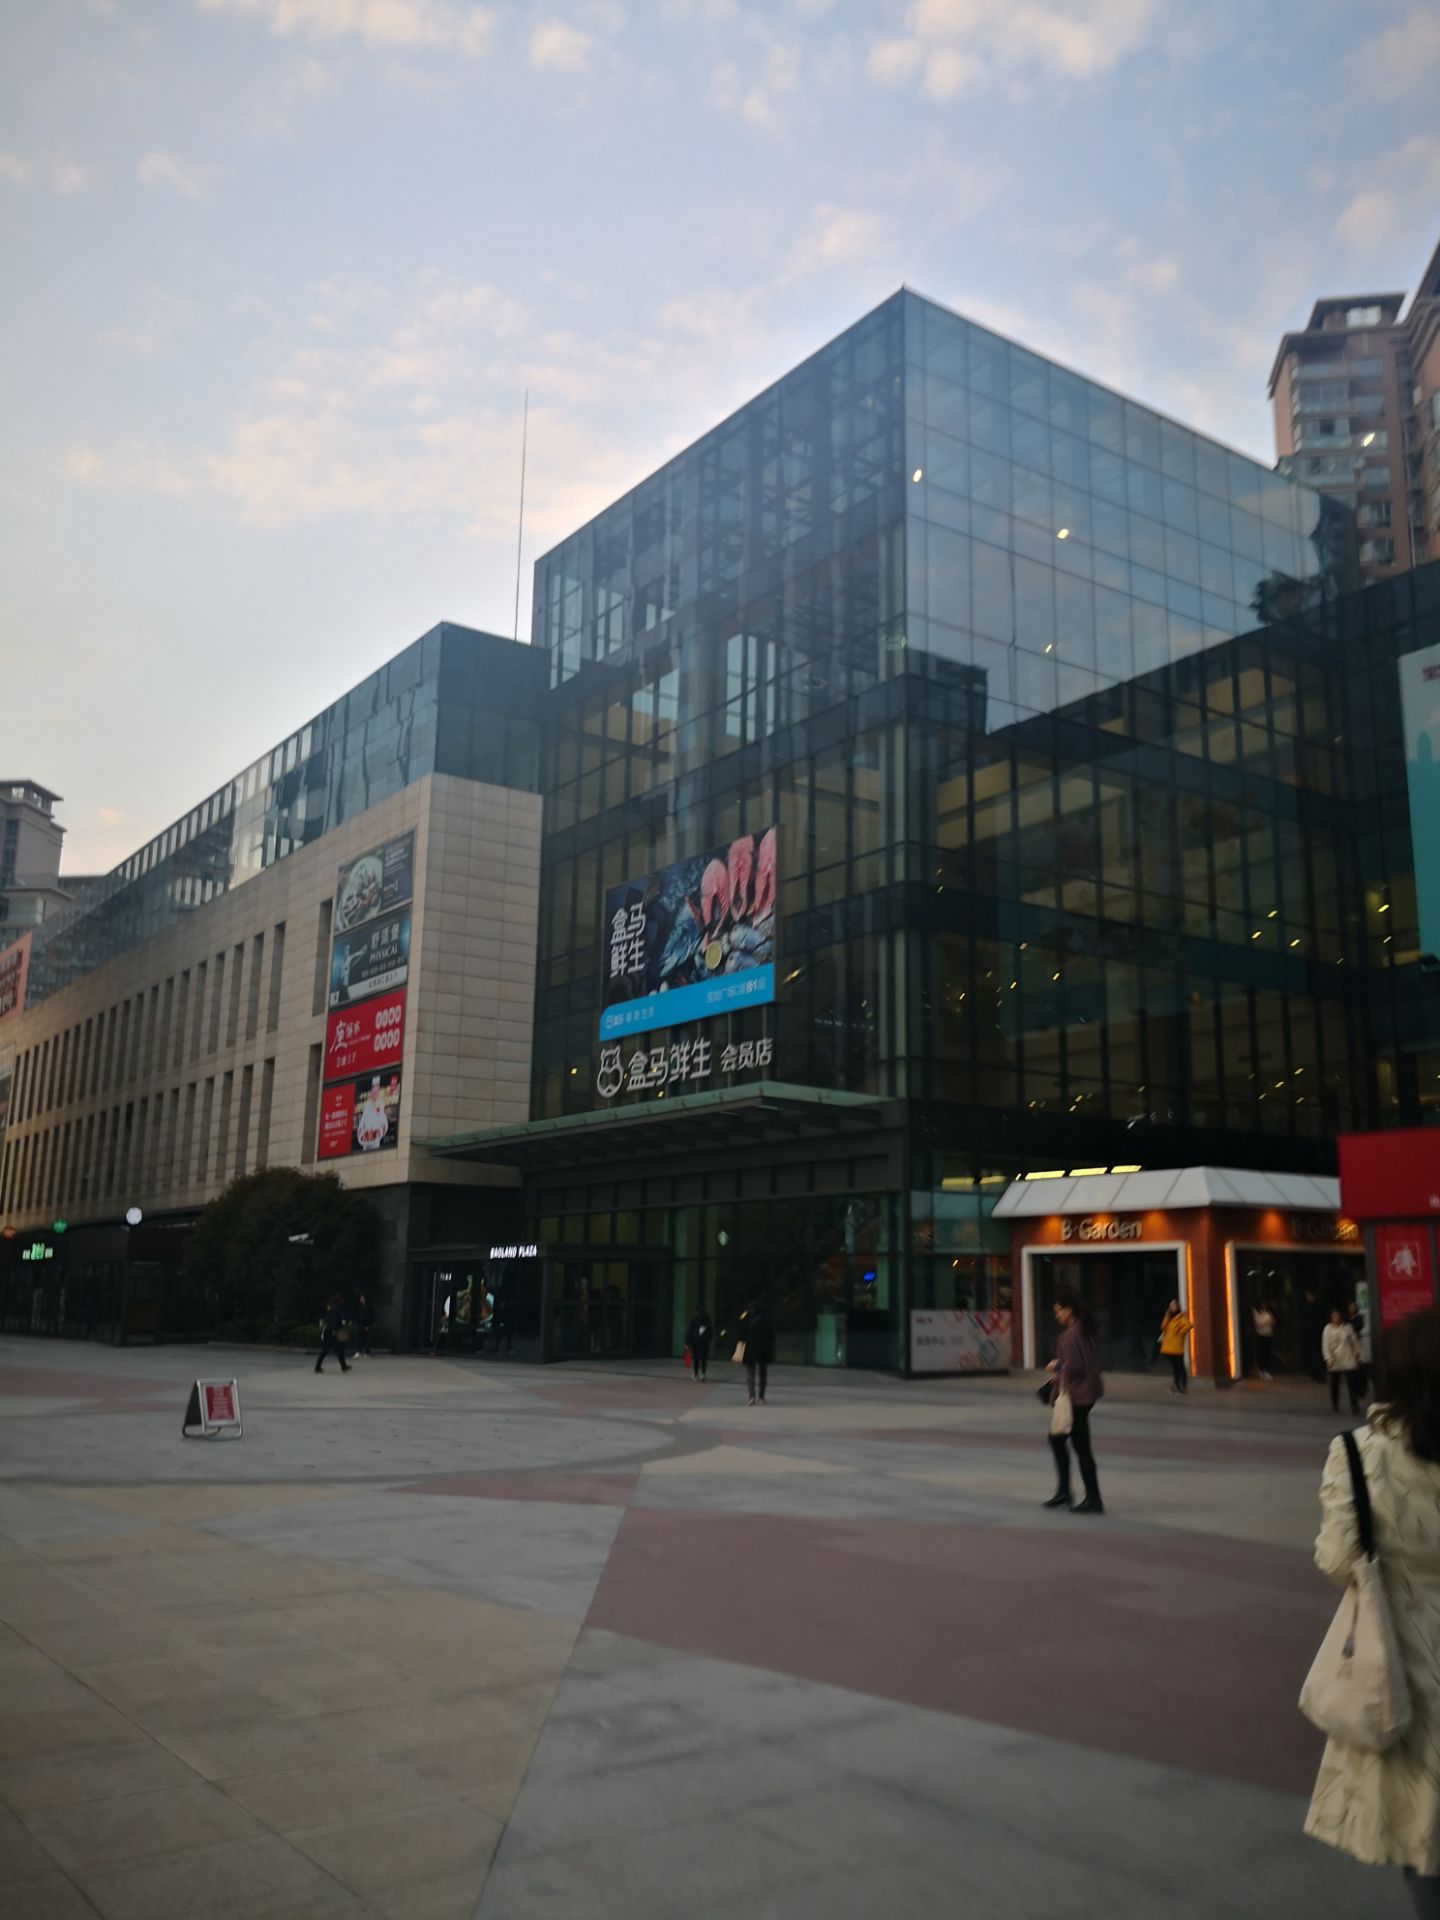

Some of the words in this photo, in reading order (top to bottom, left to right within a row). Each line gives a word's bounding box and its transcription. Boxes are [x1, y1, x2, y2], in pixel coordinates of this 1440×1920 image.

[610, 902, 646, 945] 盒马
[609, 938, 646, 979] 鲜生
[627, 1037, 712, 1091] 盒马鲜生
[720, 1038, 773, 1074] 会员店
[518, 1244, 537, 1258] PLAZA
